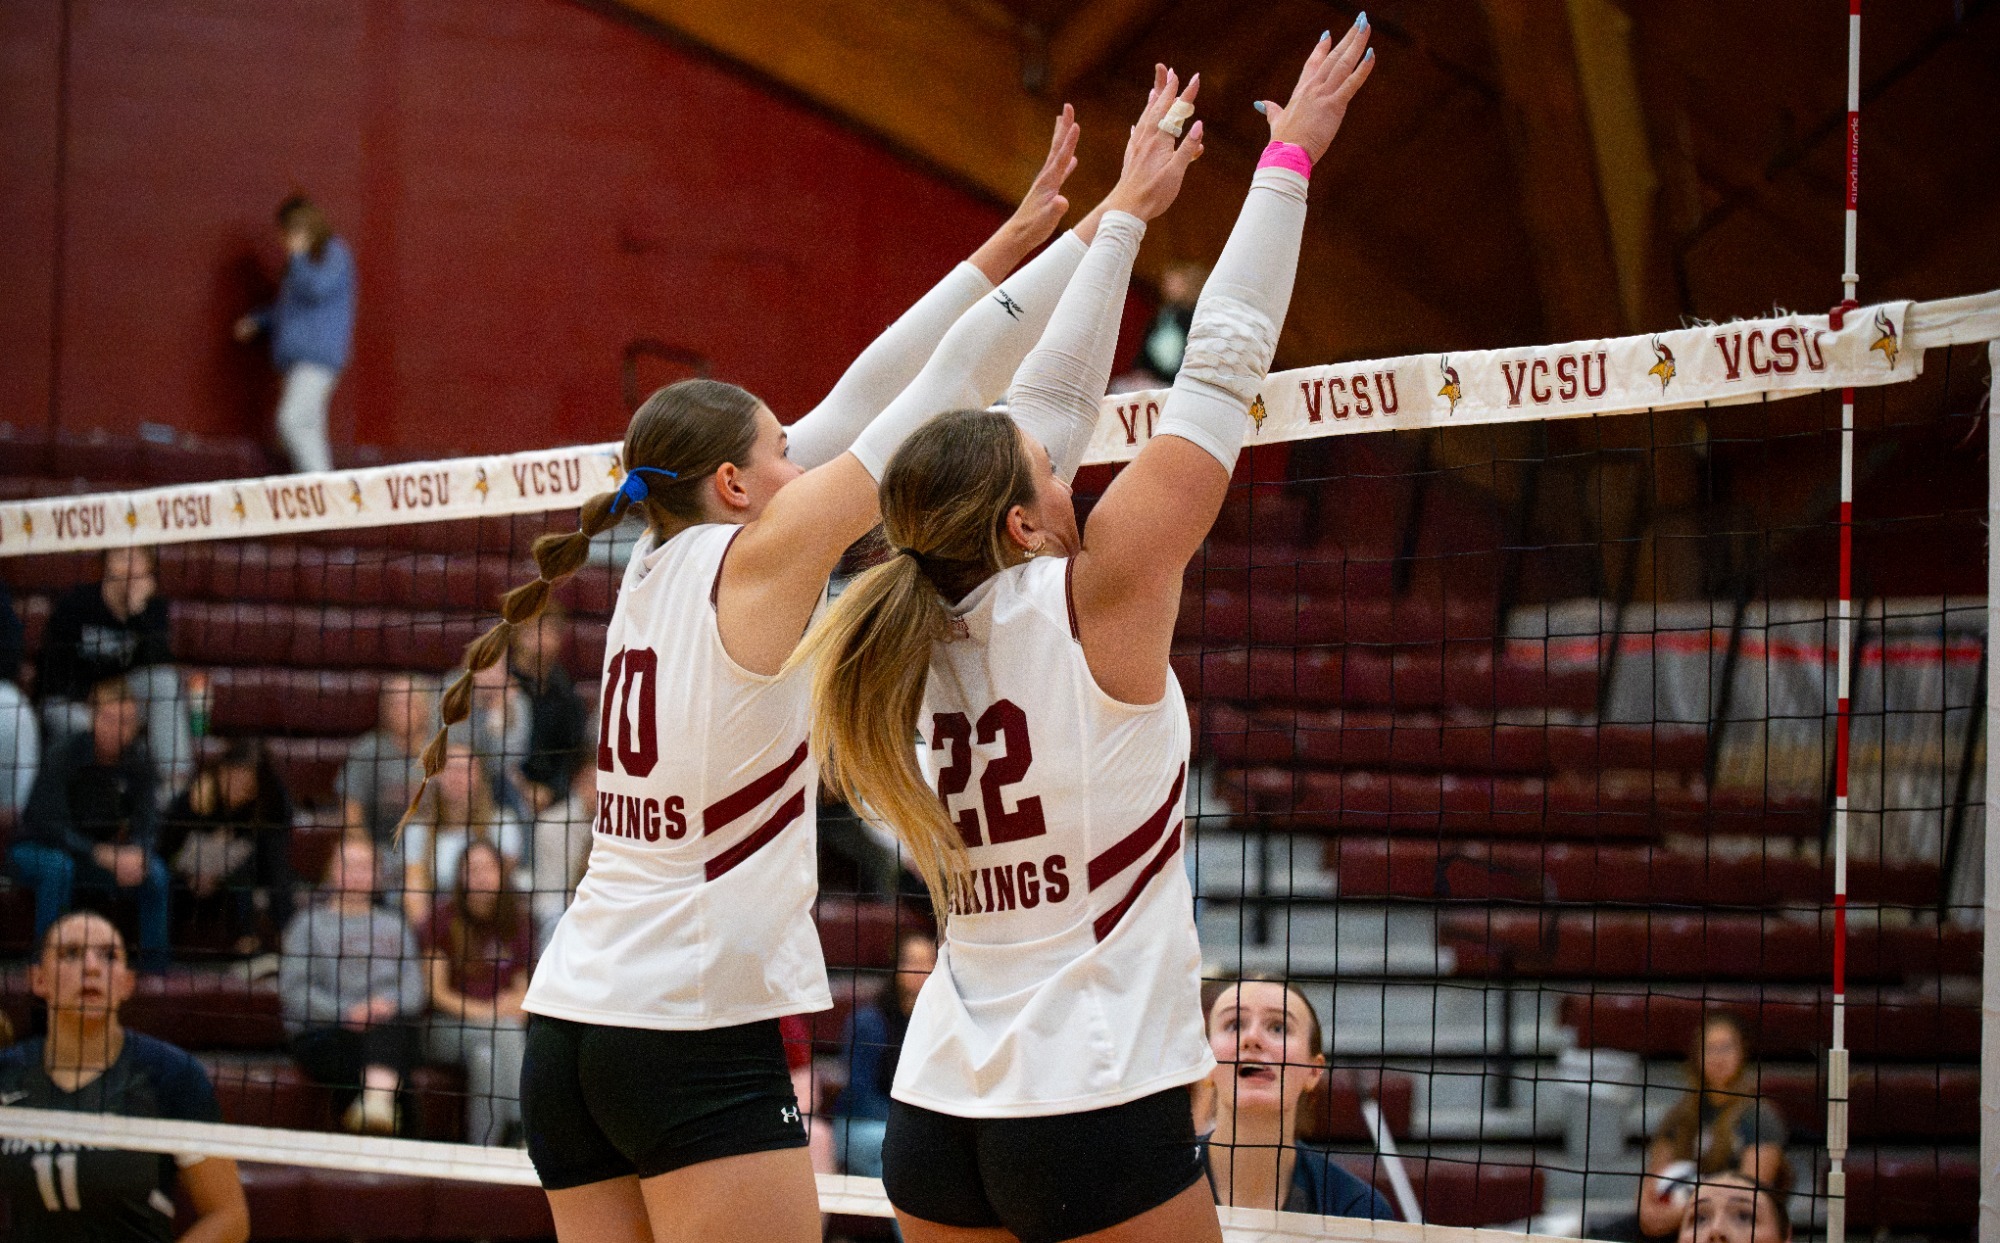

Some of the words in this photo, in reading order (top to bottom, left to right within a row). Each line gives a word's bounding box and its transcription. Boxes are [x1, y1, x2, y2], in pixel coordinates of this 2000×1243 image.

[1116, 401, 1159, 447] VC
[1299, 369, 1400, 425] VCSU
[1501, 351, 1609, 408] VCSU
[1715, 324, 1827, 383] VCSU
[52, 504, 106, 539] VCSU
[156, 494, 212, 530] VCSU
[266, 483, 327, 520] VCSU
[385, 472, 450, 510] VCSU
[513, 458, 581, 497] VCSU
[597, 645, 659, 778] 10
[597, 790, 687, 842] KINGS
[932, 698, 1047, 848] 22
[31, 1151, 82, 1212] 11
